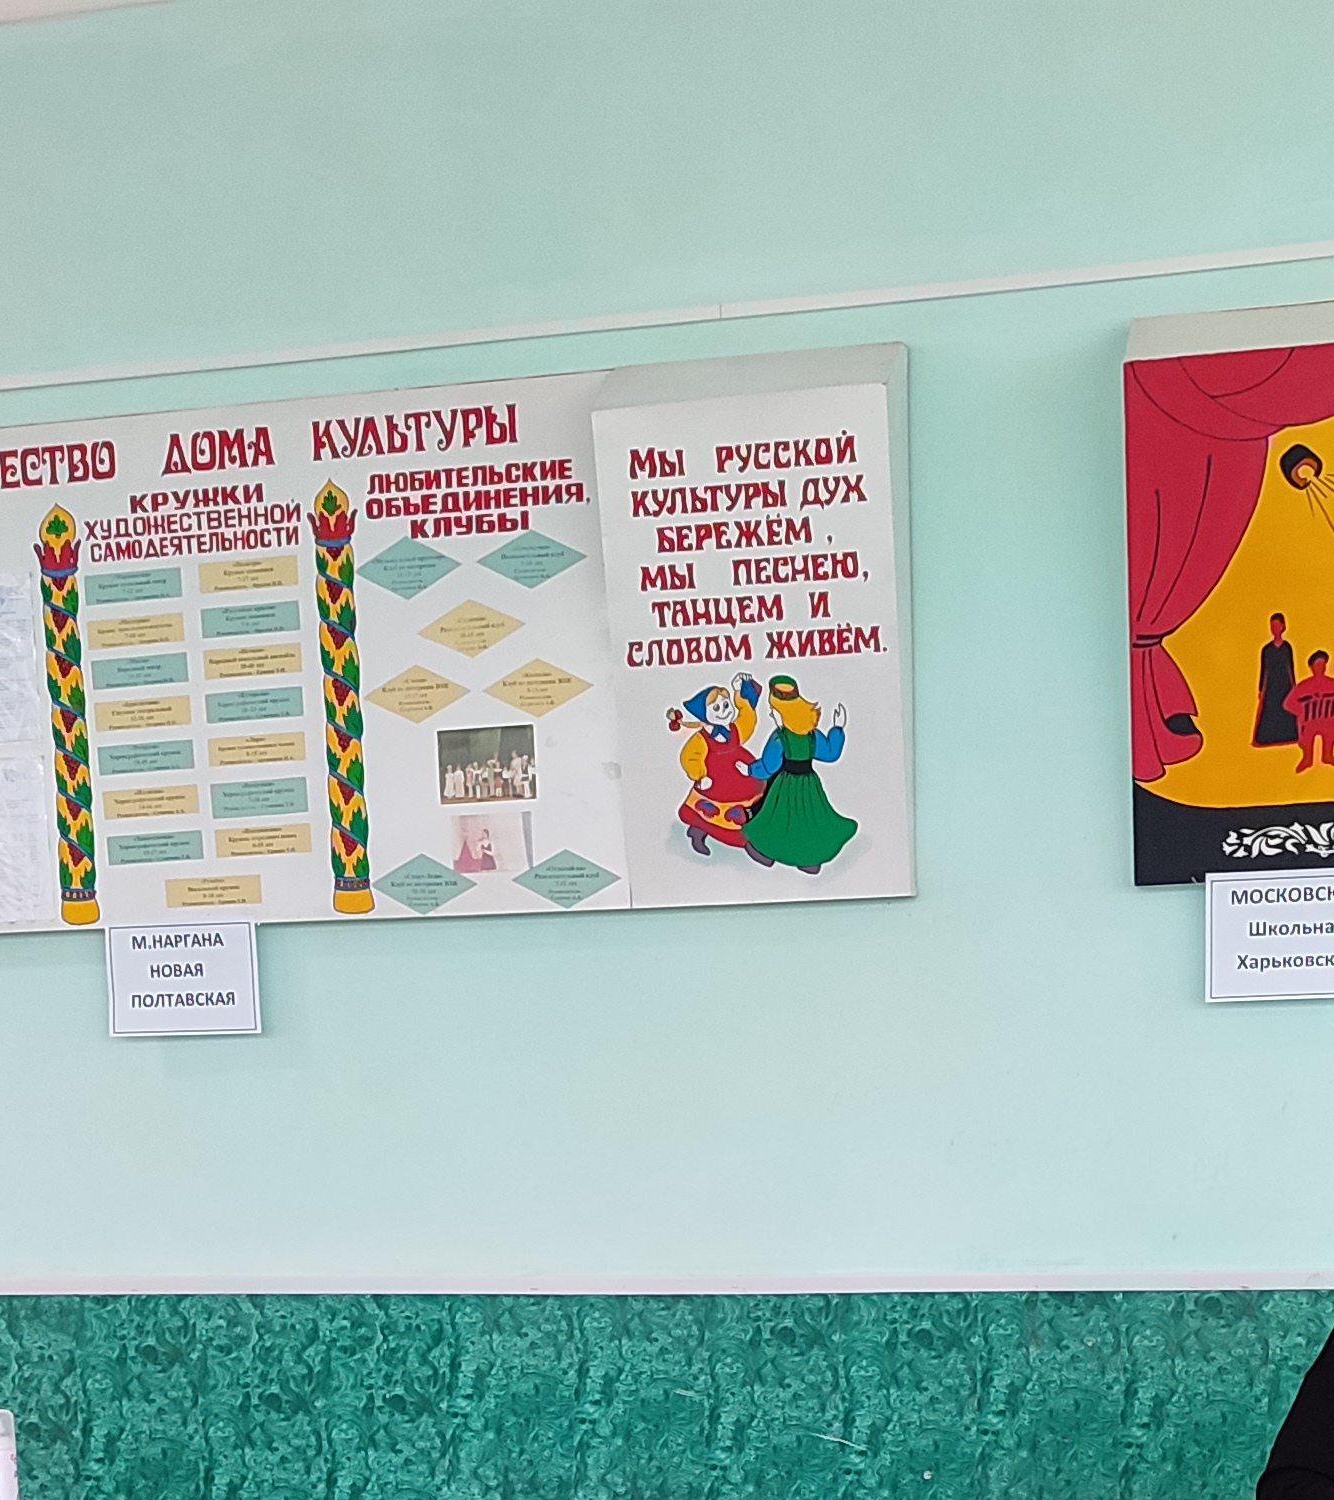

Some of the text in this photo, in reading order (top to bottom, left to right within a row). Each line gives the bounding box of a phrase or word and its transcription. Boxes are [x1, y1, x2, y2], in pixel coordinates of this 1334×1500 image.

[161, 426, 276, 477] ДОМА
[311, 403, 519, 462] КУЛЬТУРЫ
[715, 429, 858, 473] РУССКОЙ
[366, 458, 573, 495] ЛЮБИТЕЛЬСКИЕ
[129, 483, 264, 514] КРУЖКИ
[365, 482, 591, 520] ОБЪЕДИНЕНИЯ,
[631, 474, 868, 518] КУЛЬТУРЫ ДУХ
[83, 502, 302, 541] ХУДОЖЕСТВЕННОЙ
[409, 510, 530, 540] КЛУБЫ
[89, 526, 300, 563] САМОДЕЯТЕЛЬНОСТИ
[640, 551, 869, 592] МЫ ПЕСНЕЮ,
[651, 591, 831, 629] ТАНЦЕМ И
[626, 622, 889, 667] СЛОВОМ ЖИВЁМ.
[131, 932, 225, 950] М.НАРГАНА
[149, 963, 204, 979] НОВАЯ
[130, 991, 236, 1009] ПОЛТАВСКАЯ
